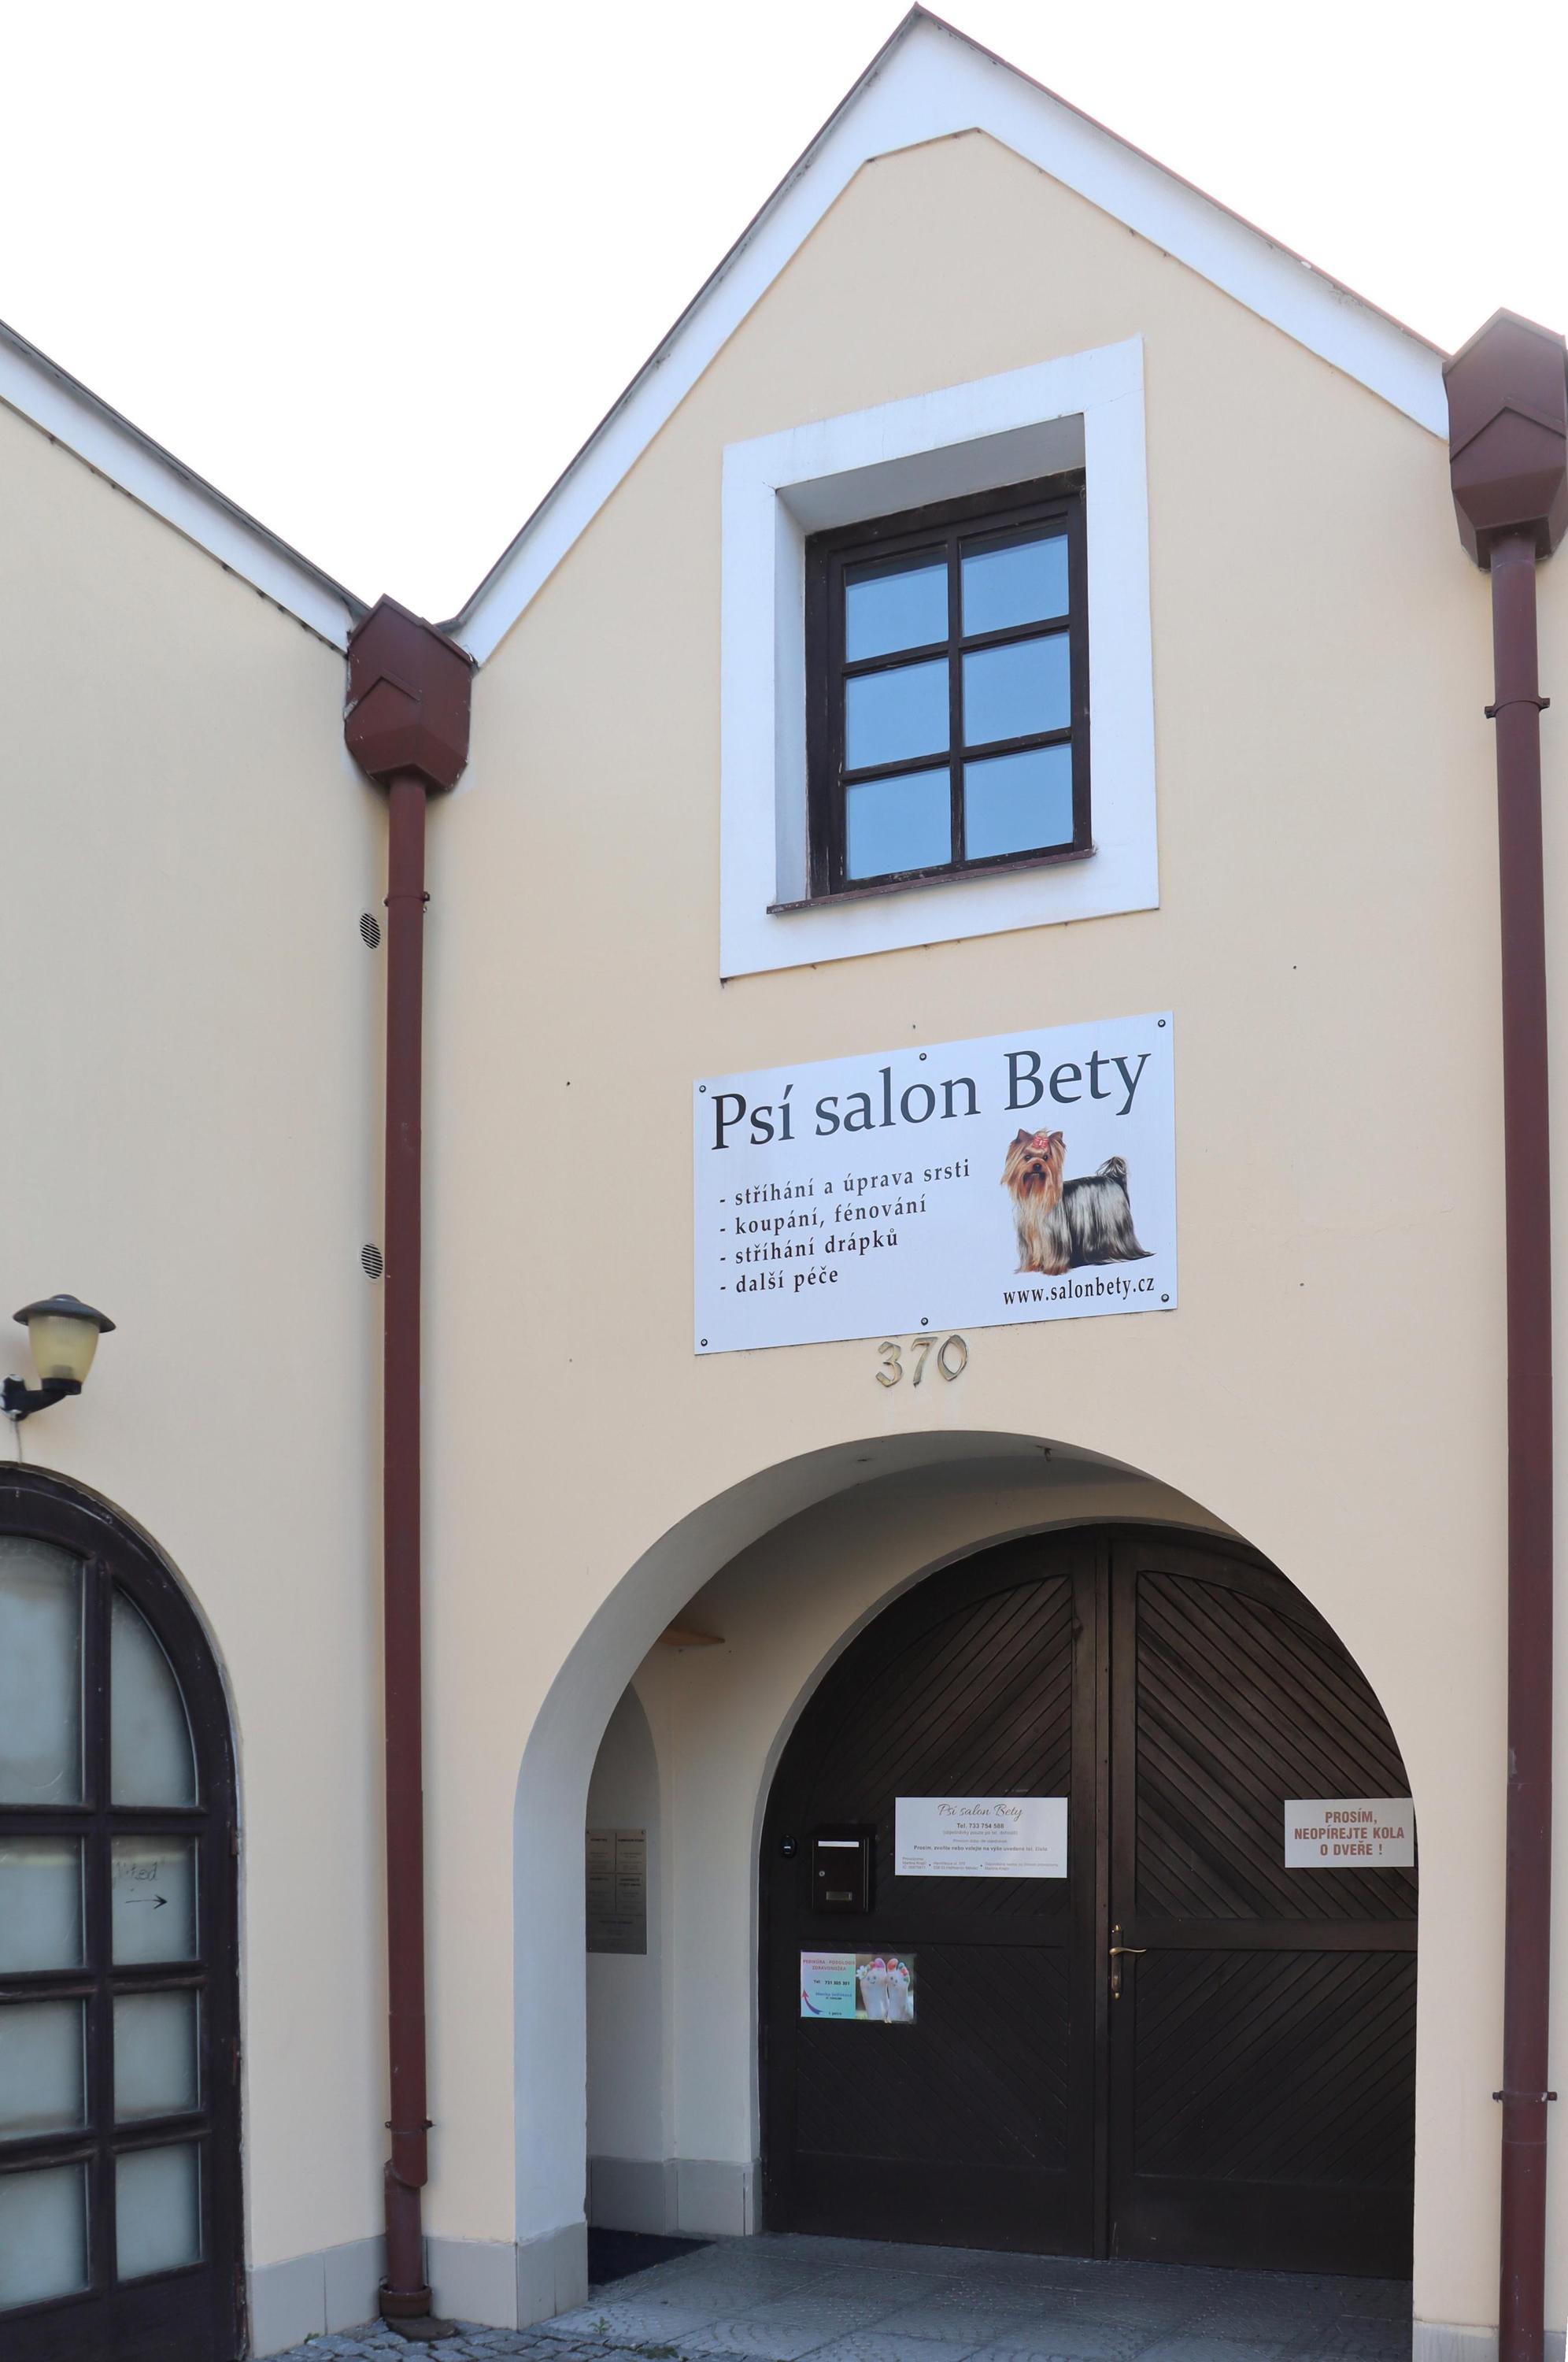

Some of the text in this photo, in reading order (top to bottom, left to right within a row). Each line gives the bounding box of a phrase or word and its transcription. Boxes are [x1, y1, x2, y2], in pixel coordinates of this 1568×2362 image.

[711, 1050, 1152, 1150] Psí salon Bety
[734, 1178, 814, 1206] stříhání
[824, 1182, 834, 1195] a
[843, 1172, 913, 1196] úprava
[923, 1158, 970, 1183] srsti
[735, 1207, 825, 1236] koupání,
[834, 1194, 926, 1223] fénování
[735, 1237, 815, 1264] stříhání
[825, 1227, 898, 1256] drápků
[736, 1270, 784, 1293] další
[793, 1264, 839, 1293] péče
[1003, 1275, 1155, 1305] www.salonbety.cz
[875, 1335, 967, 1387] 370
[959, 1804, 989, 1816] salon
[993, 1803, 1023, 1822] Bety
[1325, 1808, 1378, 1824] PROSÍM,
[1294, 1825, 1405, 1840] NEOPÍREJTE KOLA
[1320, 1844, 1328, 1856] O
[1333, 1841, 1373, 1856] DVEŘE
